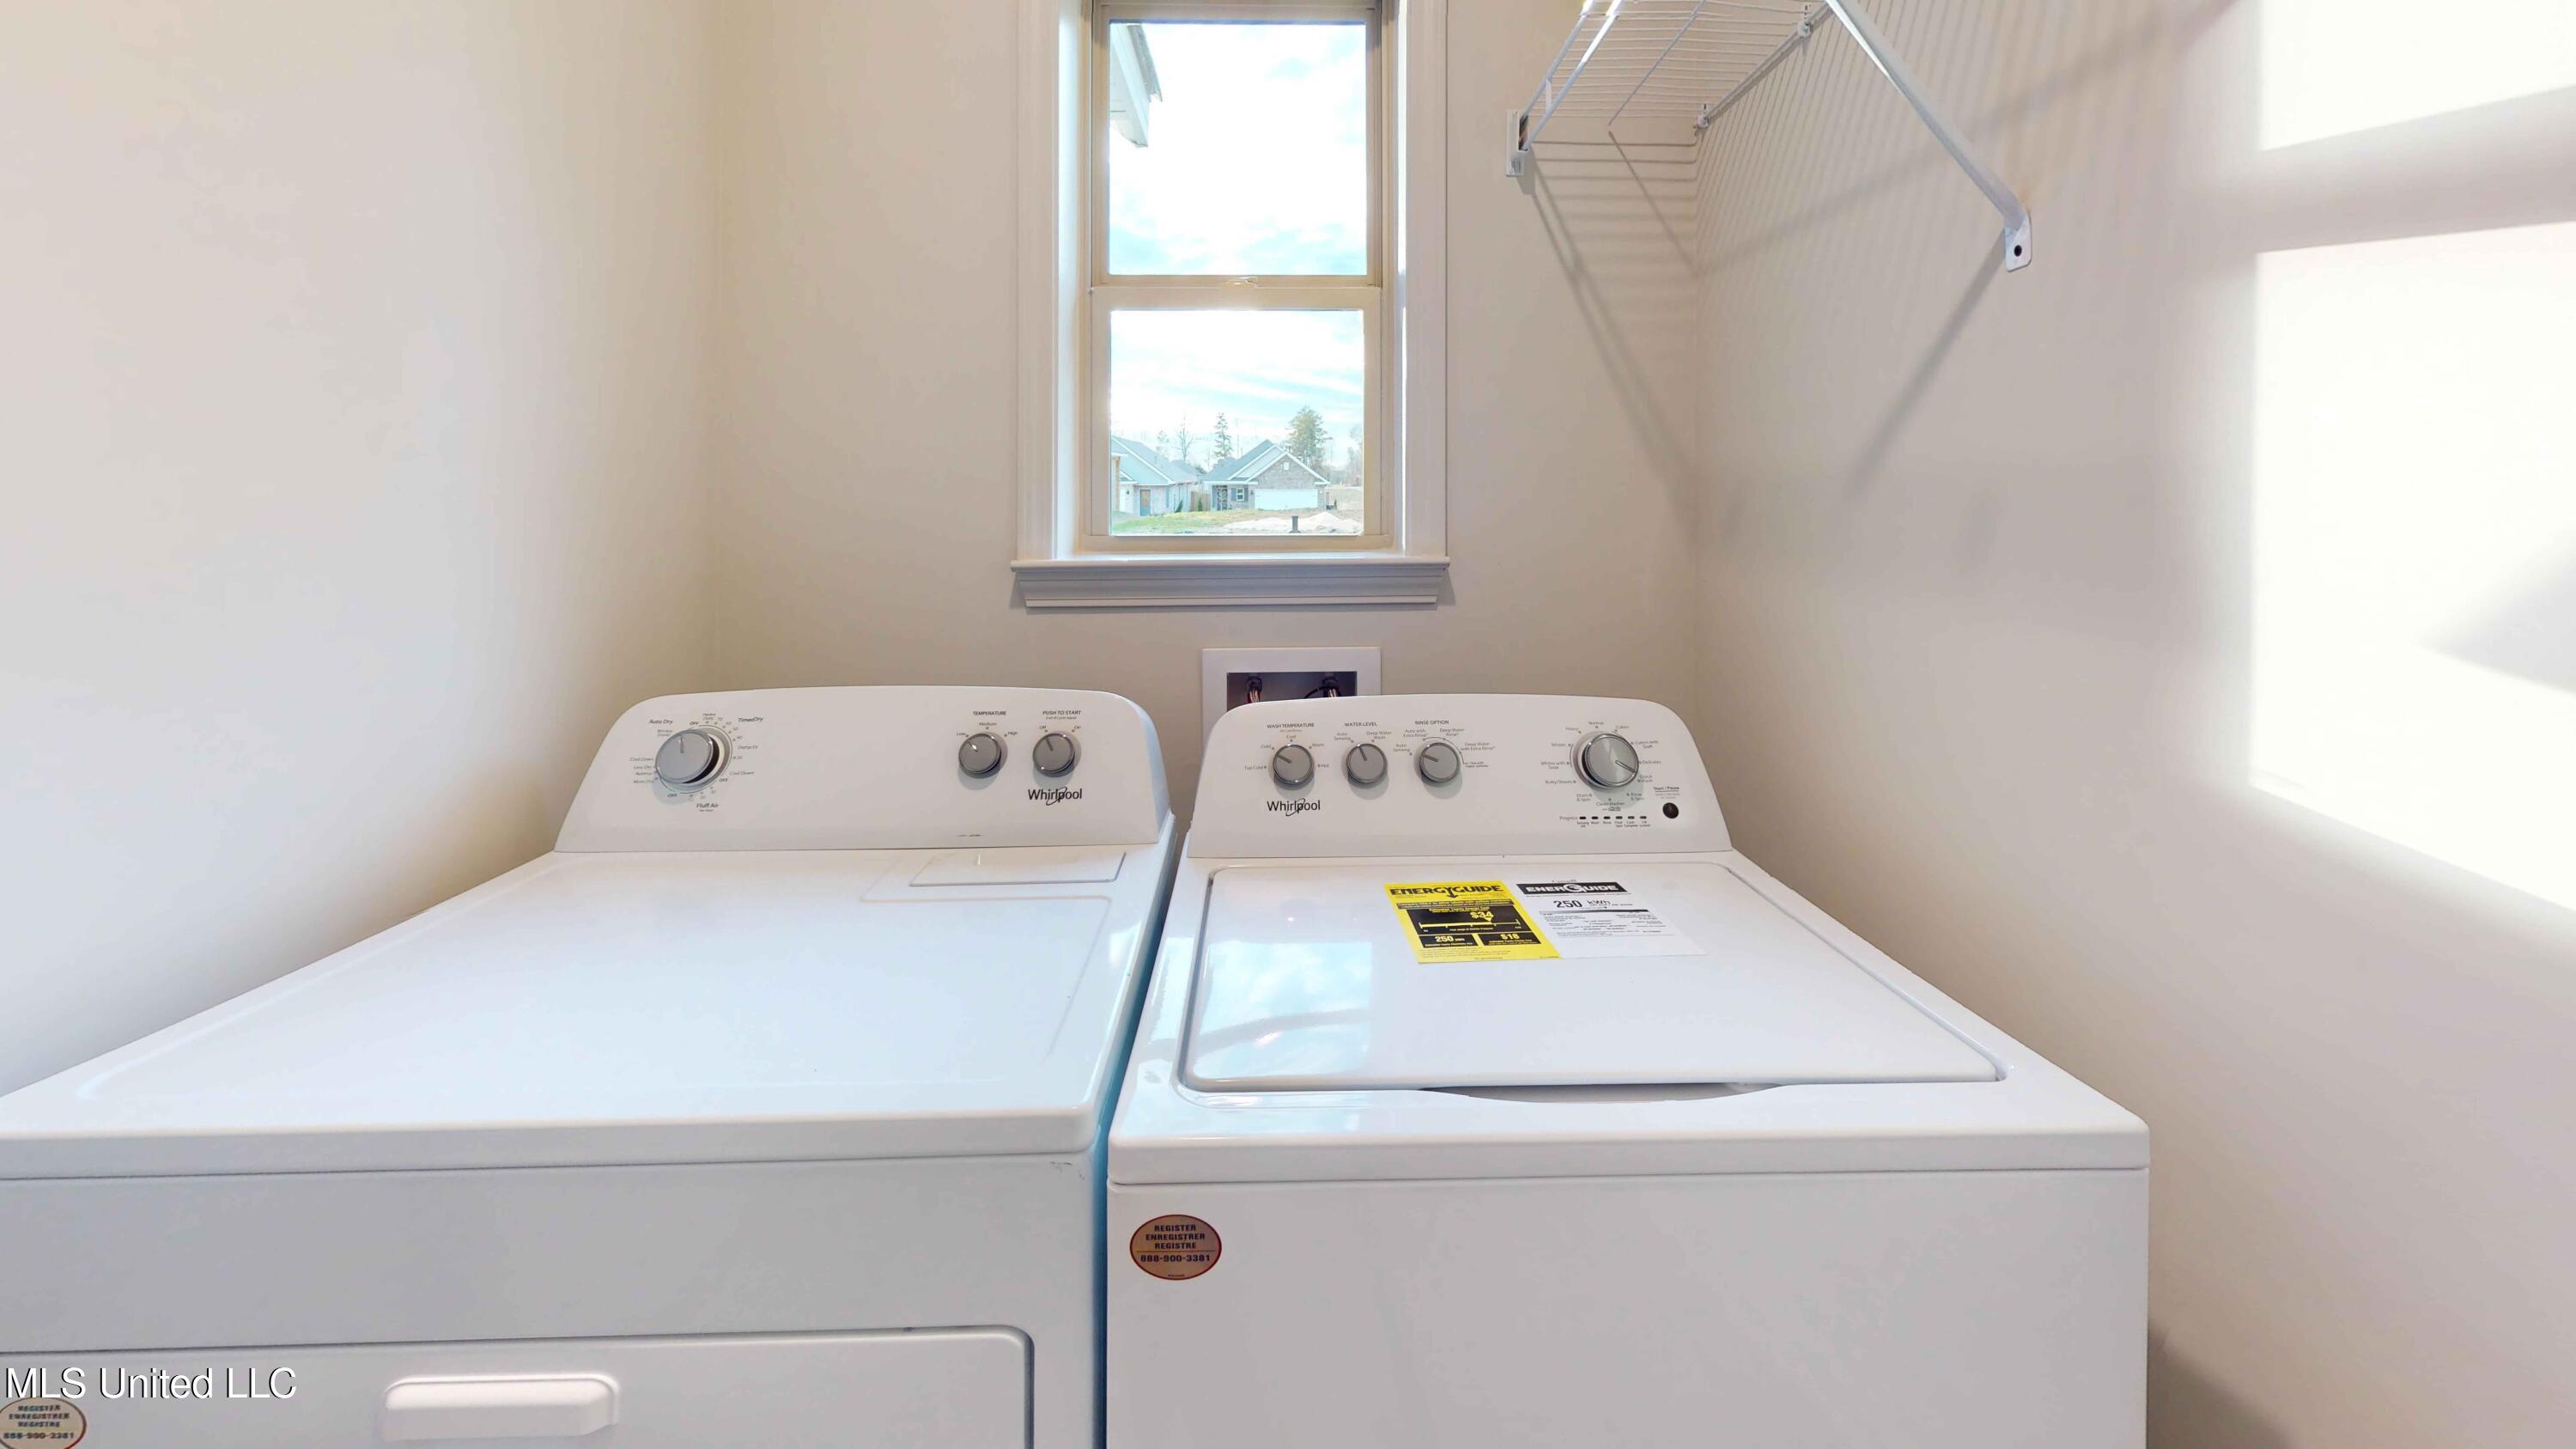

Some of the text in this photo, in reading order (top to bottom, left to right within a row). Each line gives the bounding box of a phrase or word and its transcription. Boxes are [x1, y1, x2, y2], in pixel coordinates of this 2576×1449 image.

[1028, 787, 1083, 806] Whirlpool
[1267, 798, 1321, 817] Whirlpool
[1390, 885, 1503, 898] ENERGYGUIDE
[1526, 884, 1619, 893] ENERGUIDE
